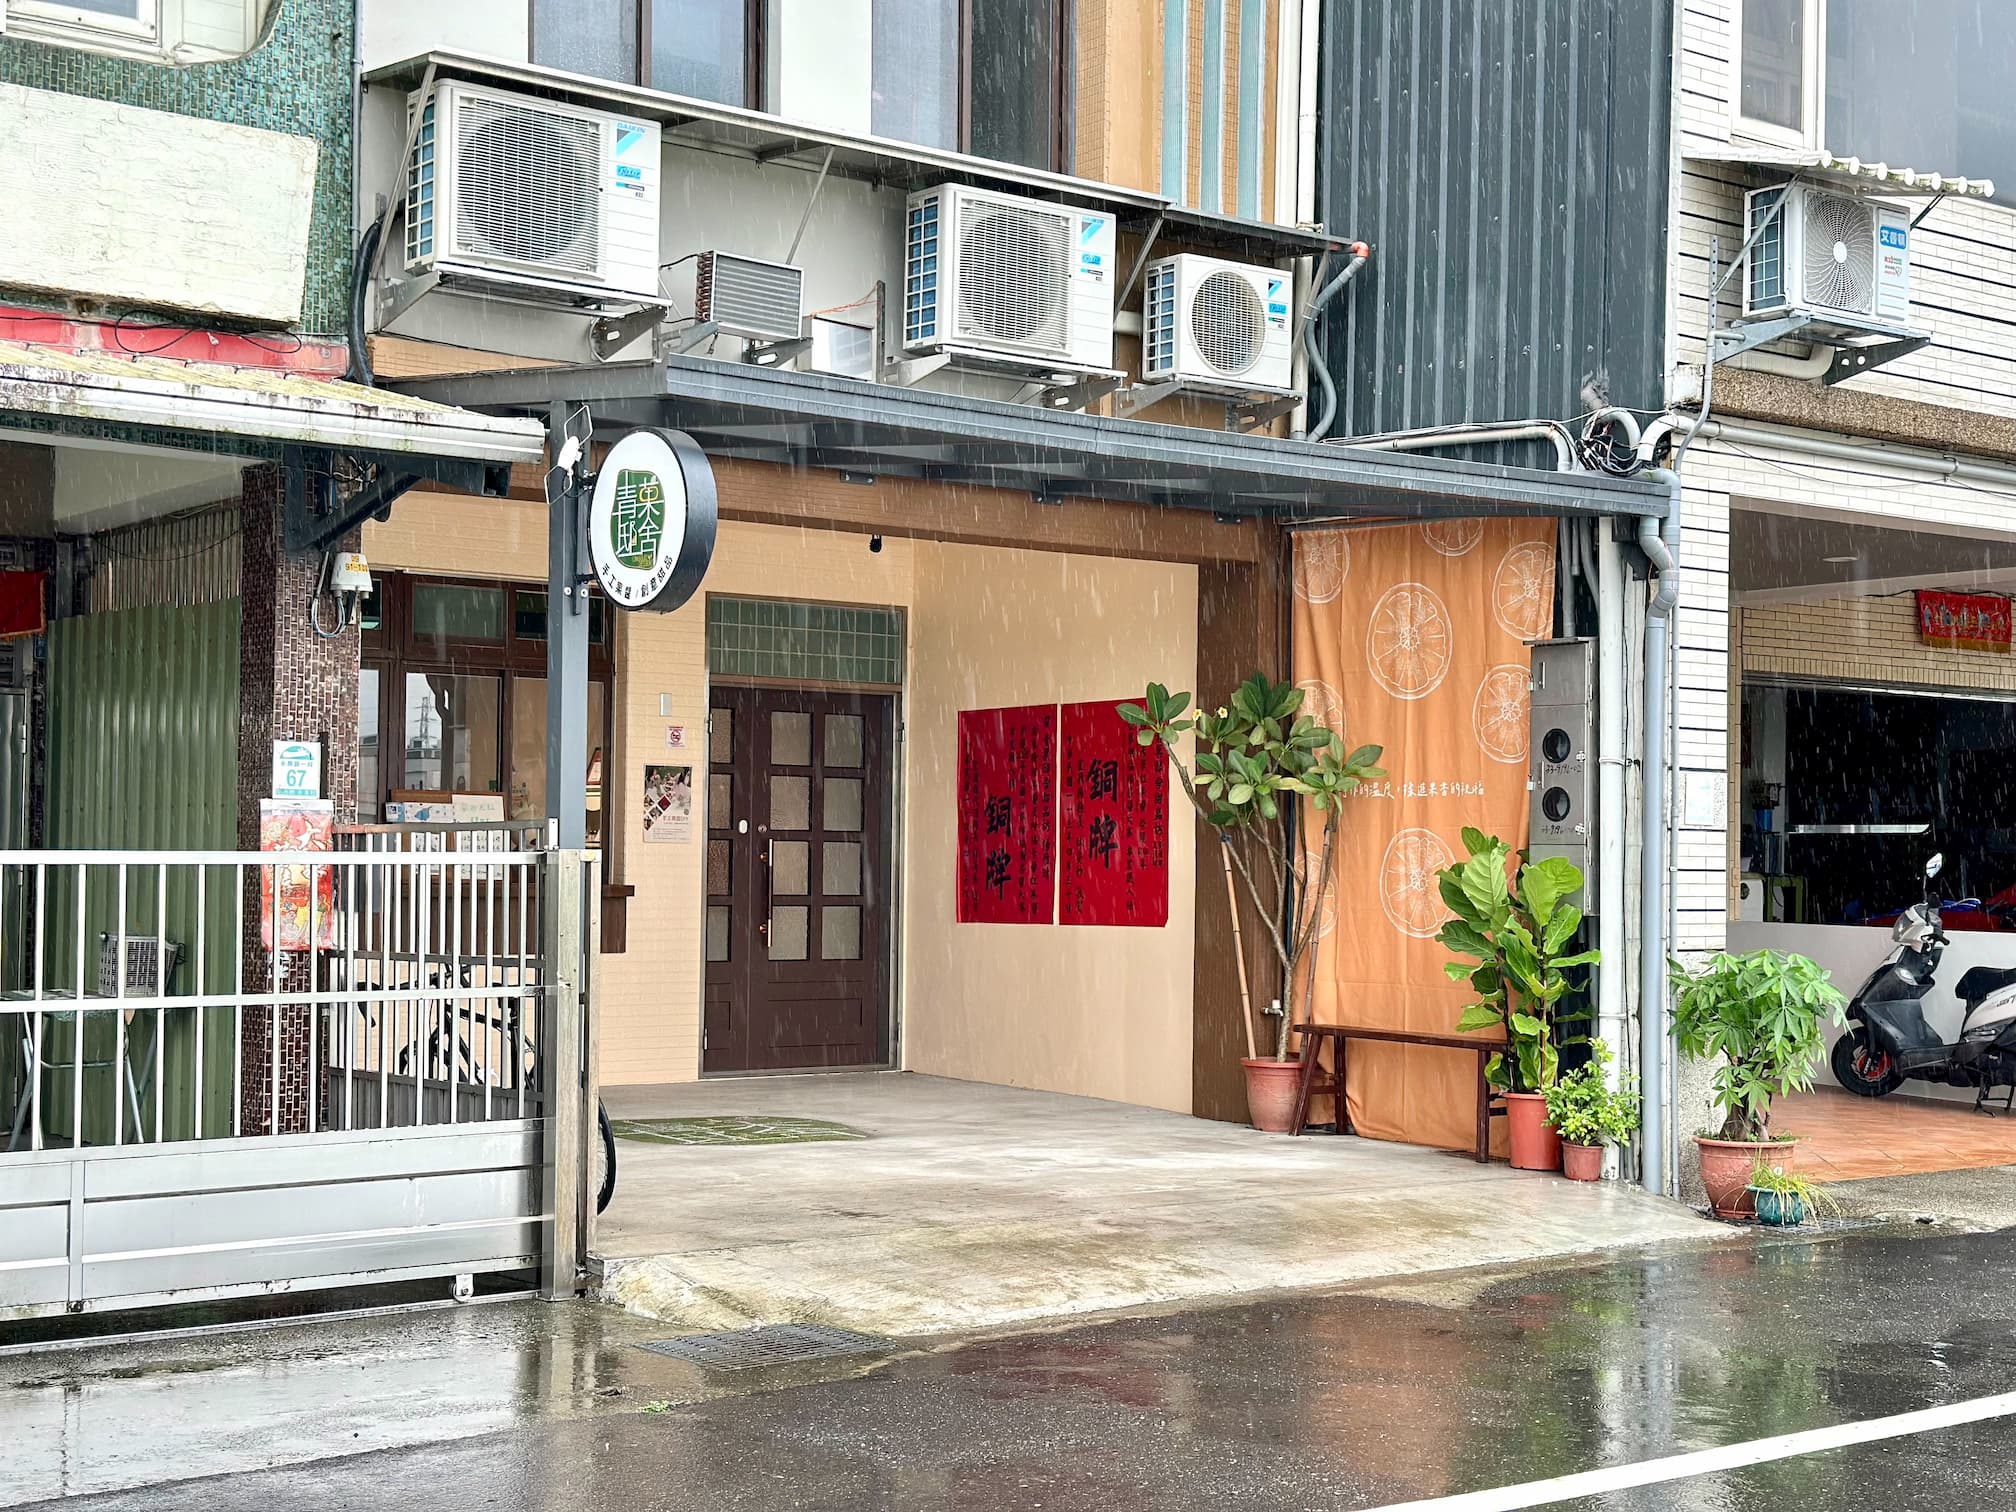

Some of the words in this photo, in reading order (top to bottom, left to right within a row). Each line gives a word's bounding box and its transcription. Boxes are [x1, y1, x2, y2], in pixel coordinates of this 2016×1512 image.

[286, 769, 306, 787] 67
[1086, 757, 1119, 869] 銅牌
[984, 795, 1012, 901] 銅牌
